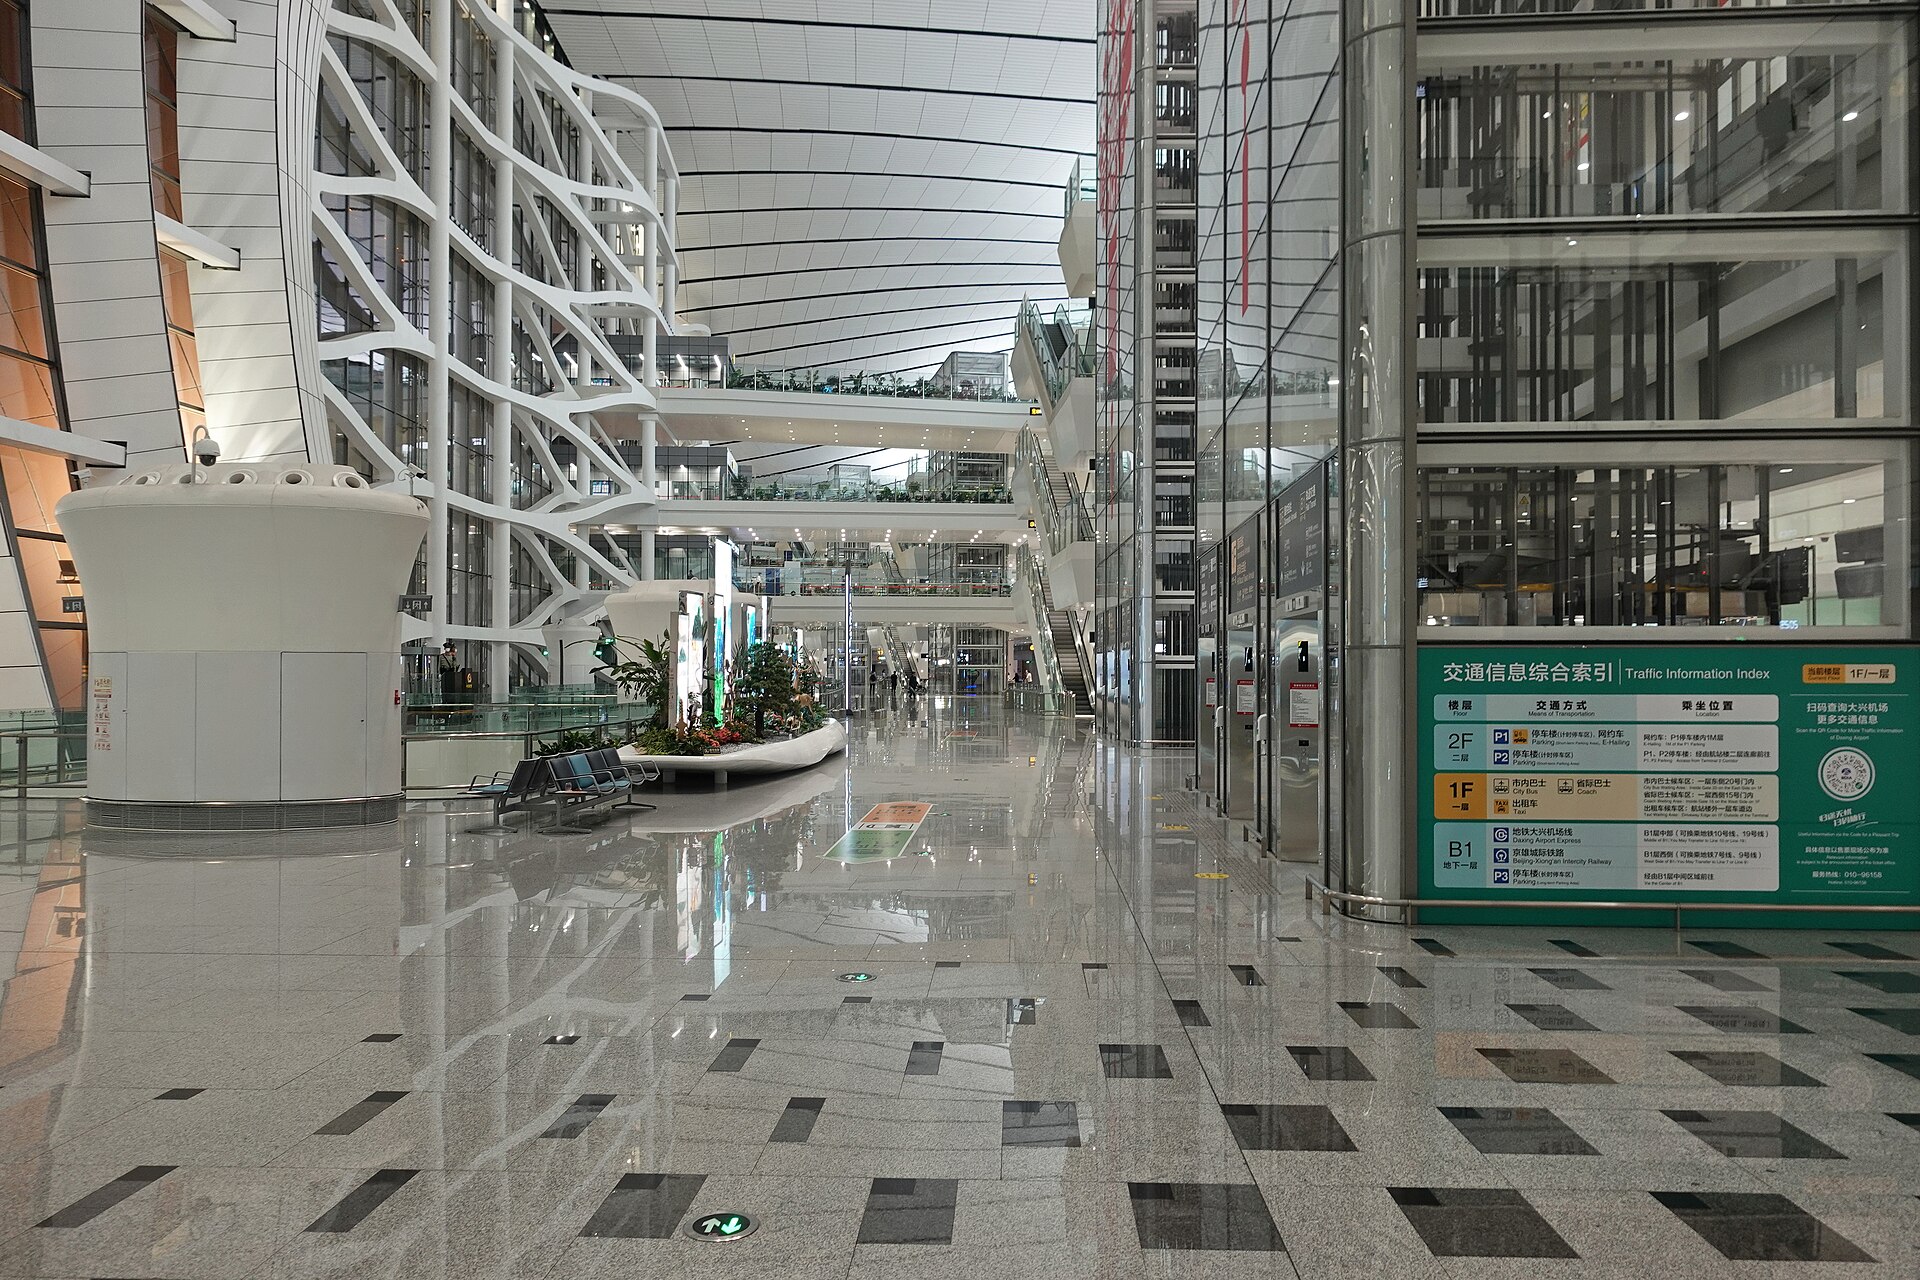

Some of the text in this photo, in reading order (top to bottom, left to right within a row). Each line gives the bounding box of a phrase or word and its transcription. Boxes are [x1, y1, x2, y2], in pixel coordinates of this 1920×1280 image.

[1443, 662, 1612, 682] 交通信息综合索引
[1625, 668, 1770, 679] Traffic Information Index
[1808, 667, 1841, 676] 当前楼层
[1850, 668, 1890, 679] 1F/一层
[1448, 700, 1473, 711] 楼层
[1536, 700, 1588, 711] 交通方式
[1682, 700, 1734, 711] 乘坐位置
[1807, 702, 1889, 713] 扫码查询大兴机场
[1817, 714, 1878, 725] 更多交通信息
[1448, 733, 1474, 749] 2F
[1495, 732, 1508, 742] P1
[1452, 753, 1469, 762] 二层
[1495, 752, 1508, 762] P2
[1512, 778, 1547, 788] 市内巴士
[1577, 779, 1612, 788] 省际巴士
[1449, 782, 1474, 798] 1F
[1512, 788, 1525, 796] City
[1452, 802, 1470, 811] 一层
[1512, 799, 1539, 808] 出租车
[1512, 827, 1573, 836] 地铁大兴机场线
[1449, 841, 1473, 858] B1
[1512, 848, 1564, 857] 京雄城际铁路
[1443, 861, 1478, 870] 地下一层
[1562, 858, 1587, 866] Intercity
[1587, 858, 1612, 866] Railway
[1494, 871, 1509, 881] P3
